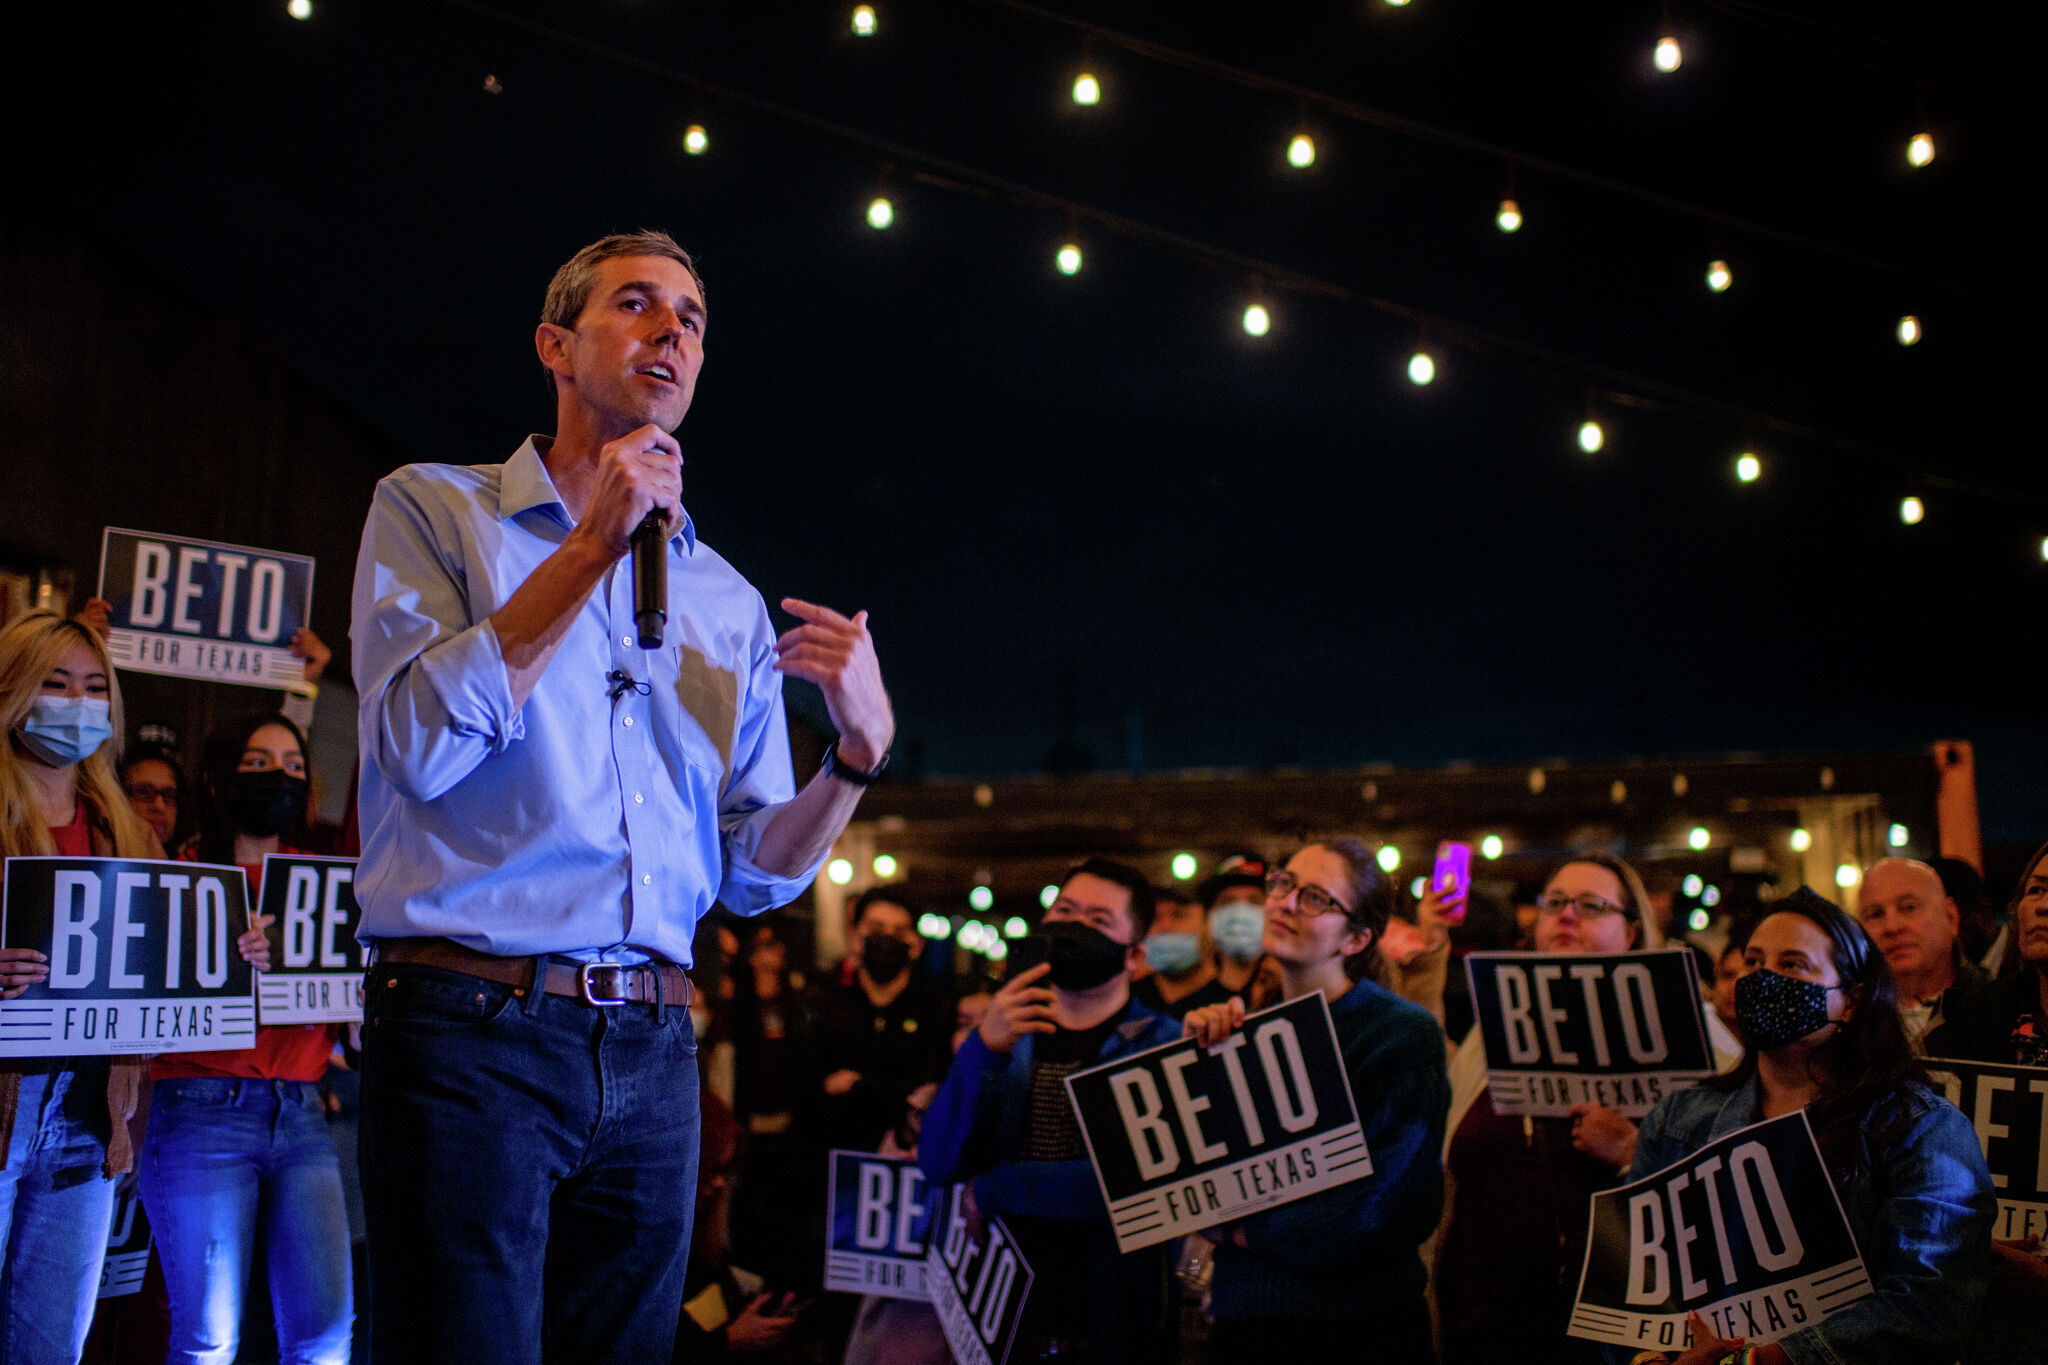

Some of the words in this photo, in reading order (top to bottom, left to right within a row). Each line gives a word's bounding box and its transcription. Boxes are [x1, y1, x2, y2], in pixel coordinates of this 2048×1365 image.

[130, 541, 284, 643] BETO
[140, 637, 180, 664] FOR
[196, 644, 262, 676] TEXAS
[49, 870, 228, 989] BETO
[284, 866, 374, 967] BE
[63, 1007, 118, 1040] FOR
[140, 1006, 213, 1039] TEXAS
[296, 981, 330, 1009] FOR
[1496, 963, 1668, 1066] BETO
[1109, 1017, 1319, 1182] BETO
[1528, 1077, 1571, 1105] FOR
[1582, 1076, 1662, 1107] TEXAS
[1166, 1179, 1221, 1222] FOR
[1233, 1147, 1317, 1201] TEXAS
[1625, 1140, 1804, 1306] BETO
[1711, 1288, 1807, 1340] TEXAS
